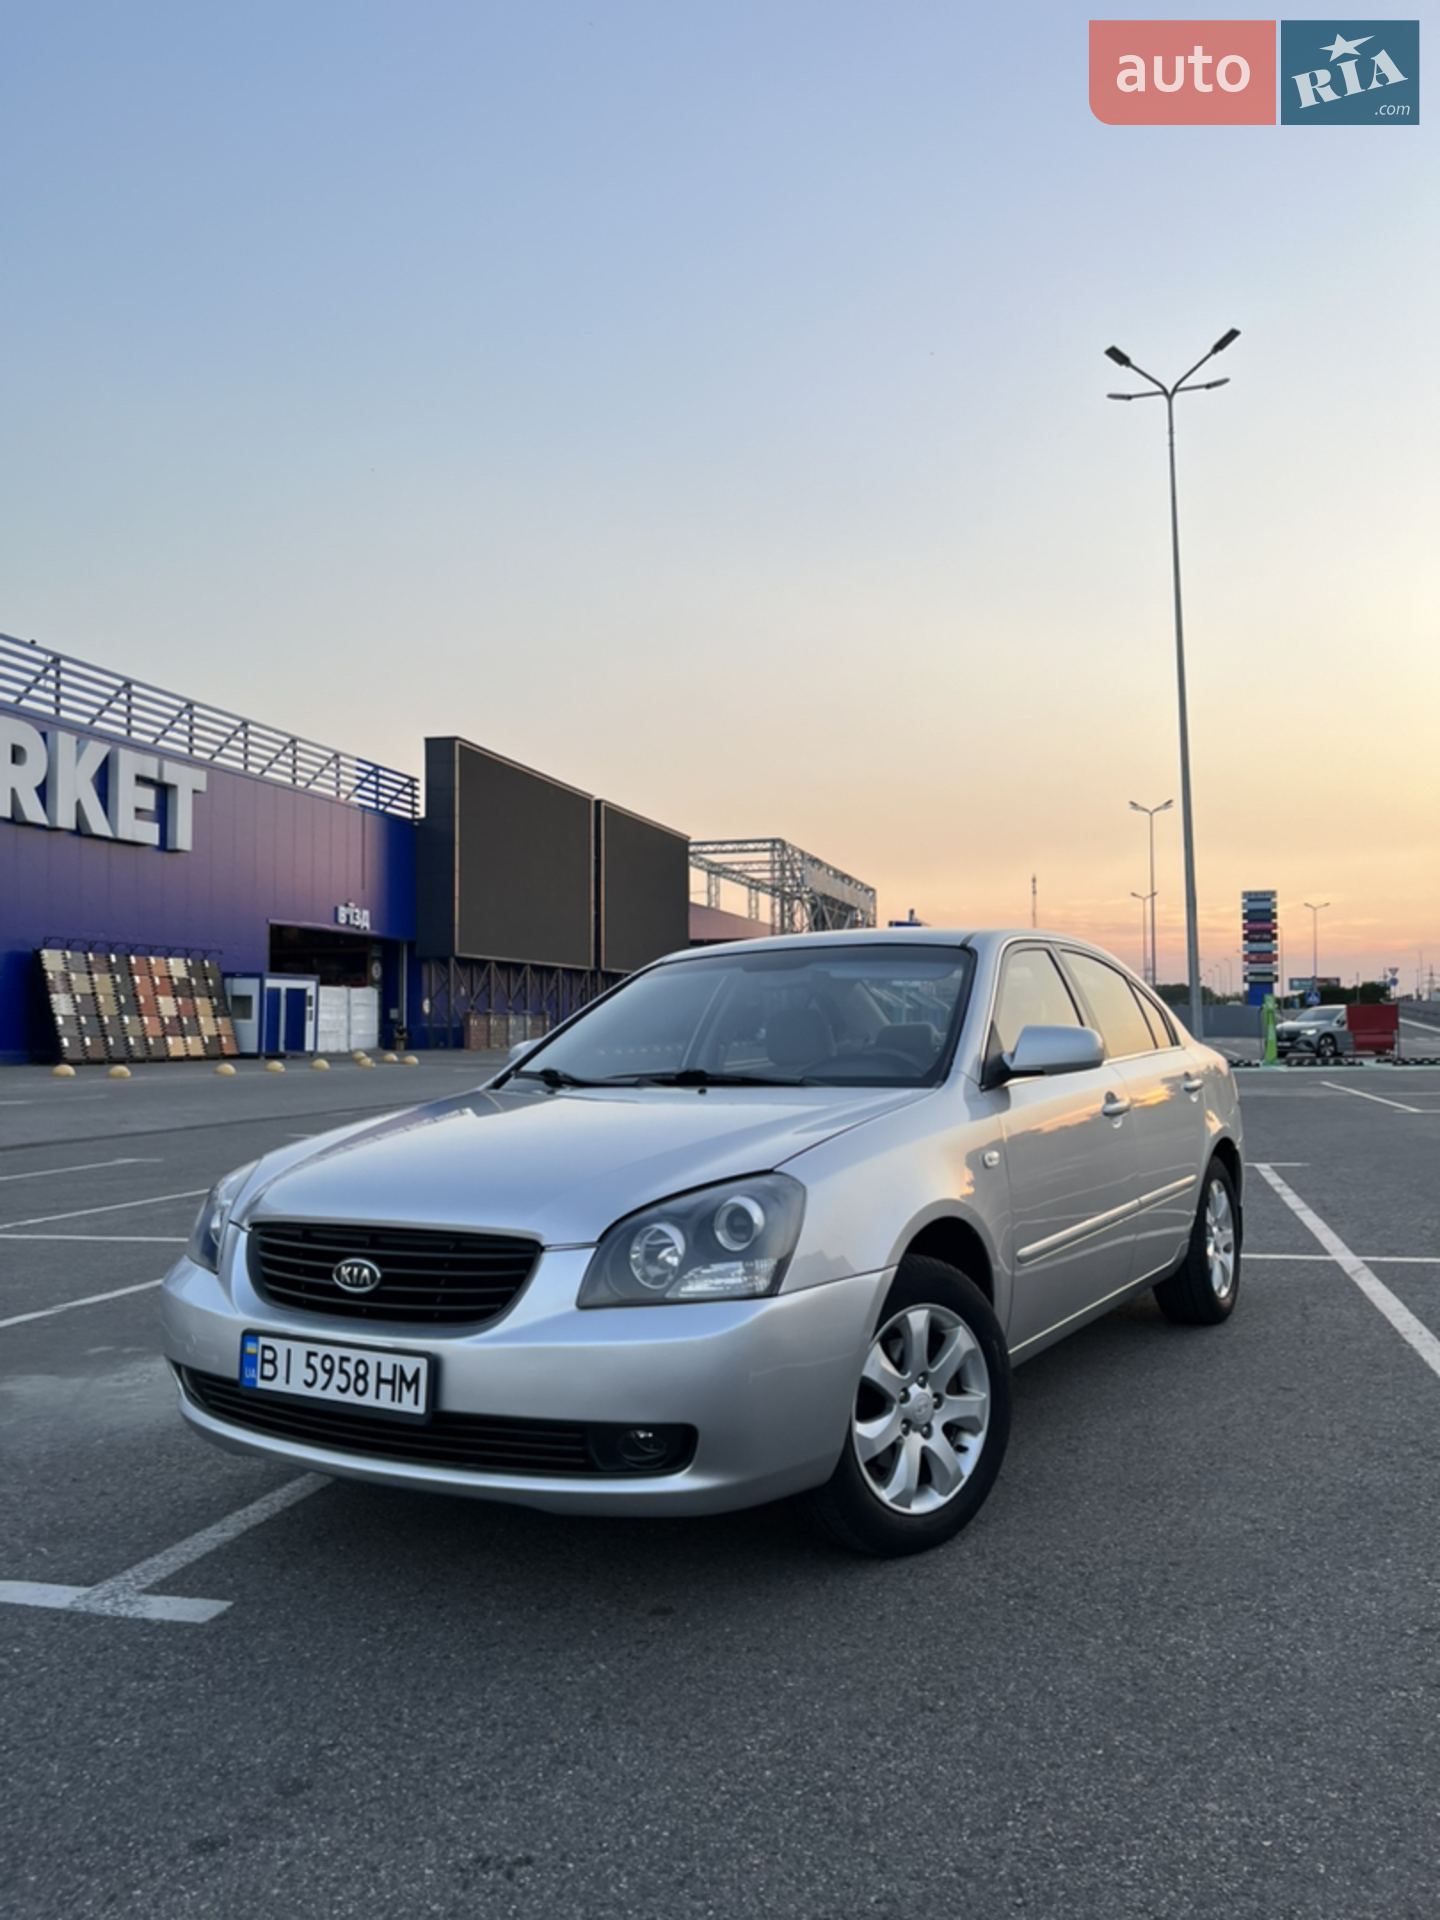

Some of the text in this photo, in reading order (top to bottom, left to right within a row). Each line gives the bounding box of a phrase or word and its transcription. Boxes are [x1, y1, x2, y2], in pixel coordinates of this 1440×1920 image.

[0, 715, 207, 852] RKET
[339, 1265, 371, 1285] KIA
[244, 1367, 256, 1379] UA
